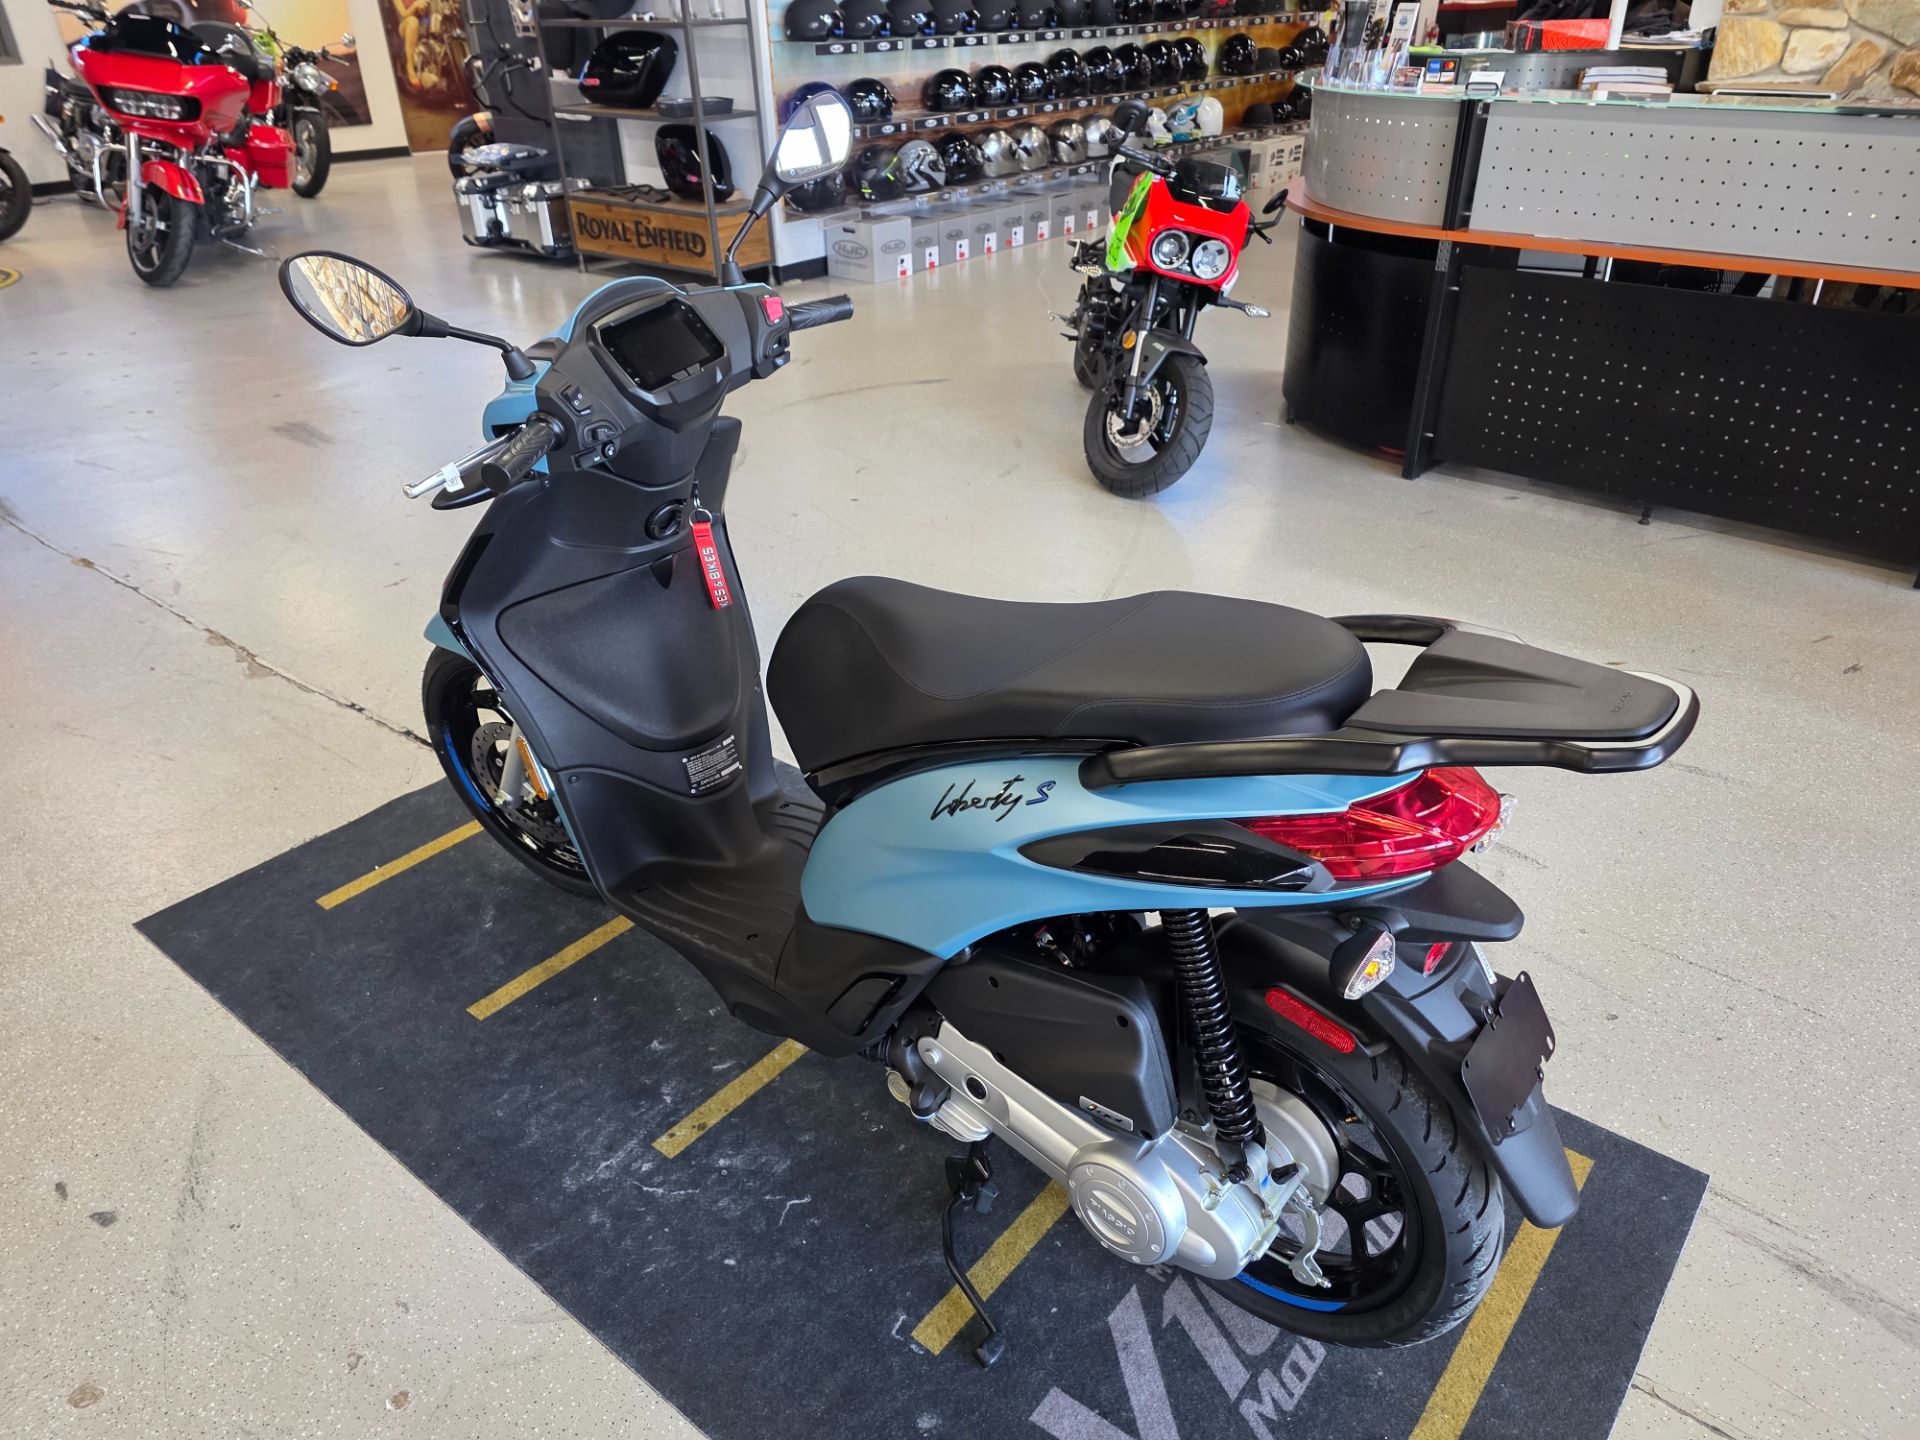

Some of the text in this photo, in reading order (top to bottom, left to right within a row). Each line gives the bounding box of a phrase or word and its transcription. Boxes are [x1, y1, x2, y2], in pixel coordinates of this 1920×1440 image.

[576, 211, 706, 258] ROYAL ENFIELD
[837, 241, 864, 255] HJC
[703, 547, 720, 579] BIKES
[930, 774, 1057, 822] Liberty S
